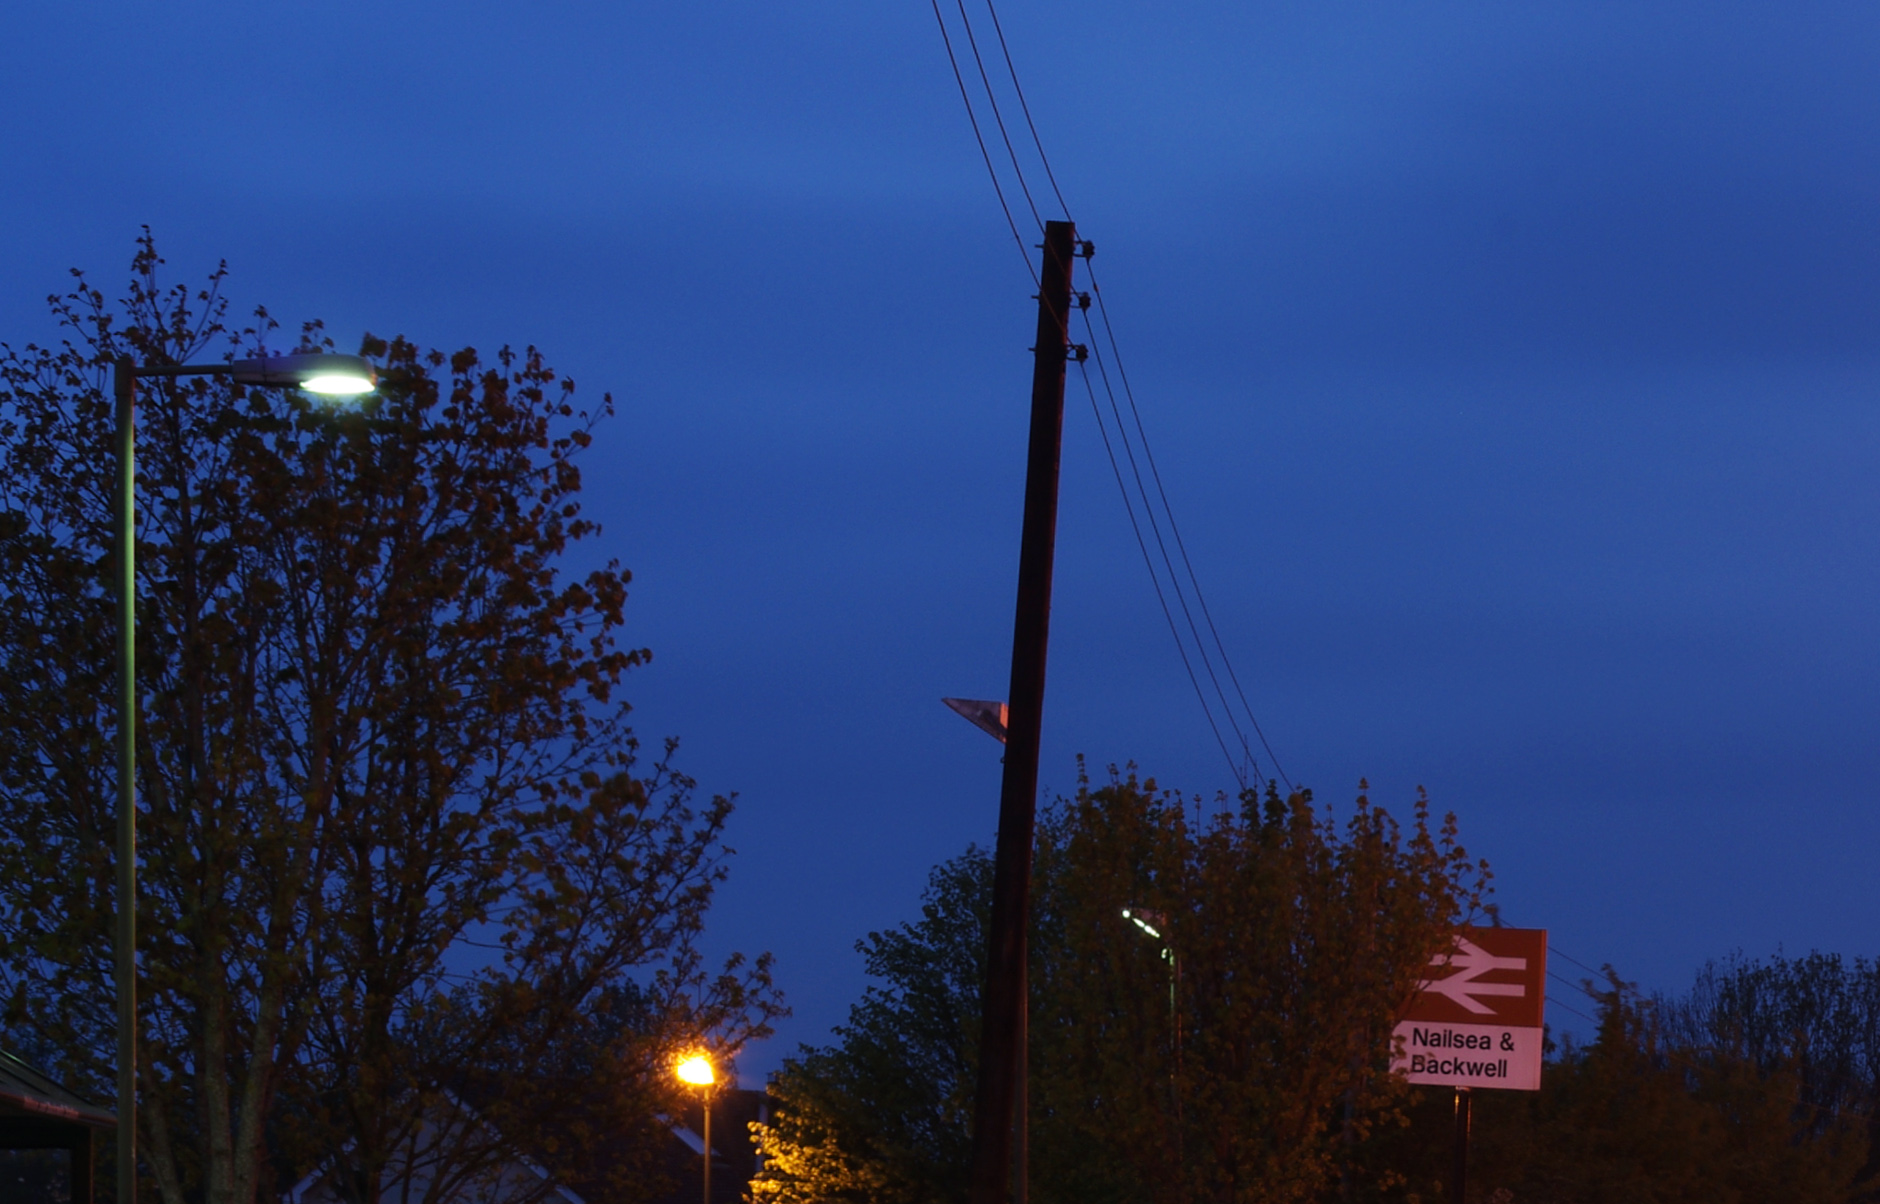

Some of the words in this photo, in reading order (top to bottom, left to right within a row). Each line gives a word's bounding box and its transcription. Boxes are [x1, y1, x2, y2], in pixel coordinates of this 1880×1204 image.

[1412, 1028, 1491, 1050] Nailsea
[1500, 1032, 1515, 1052] &
[1411, 1054, 1508, 1078] Backwell
